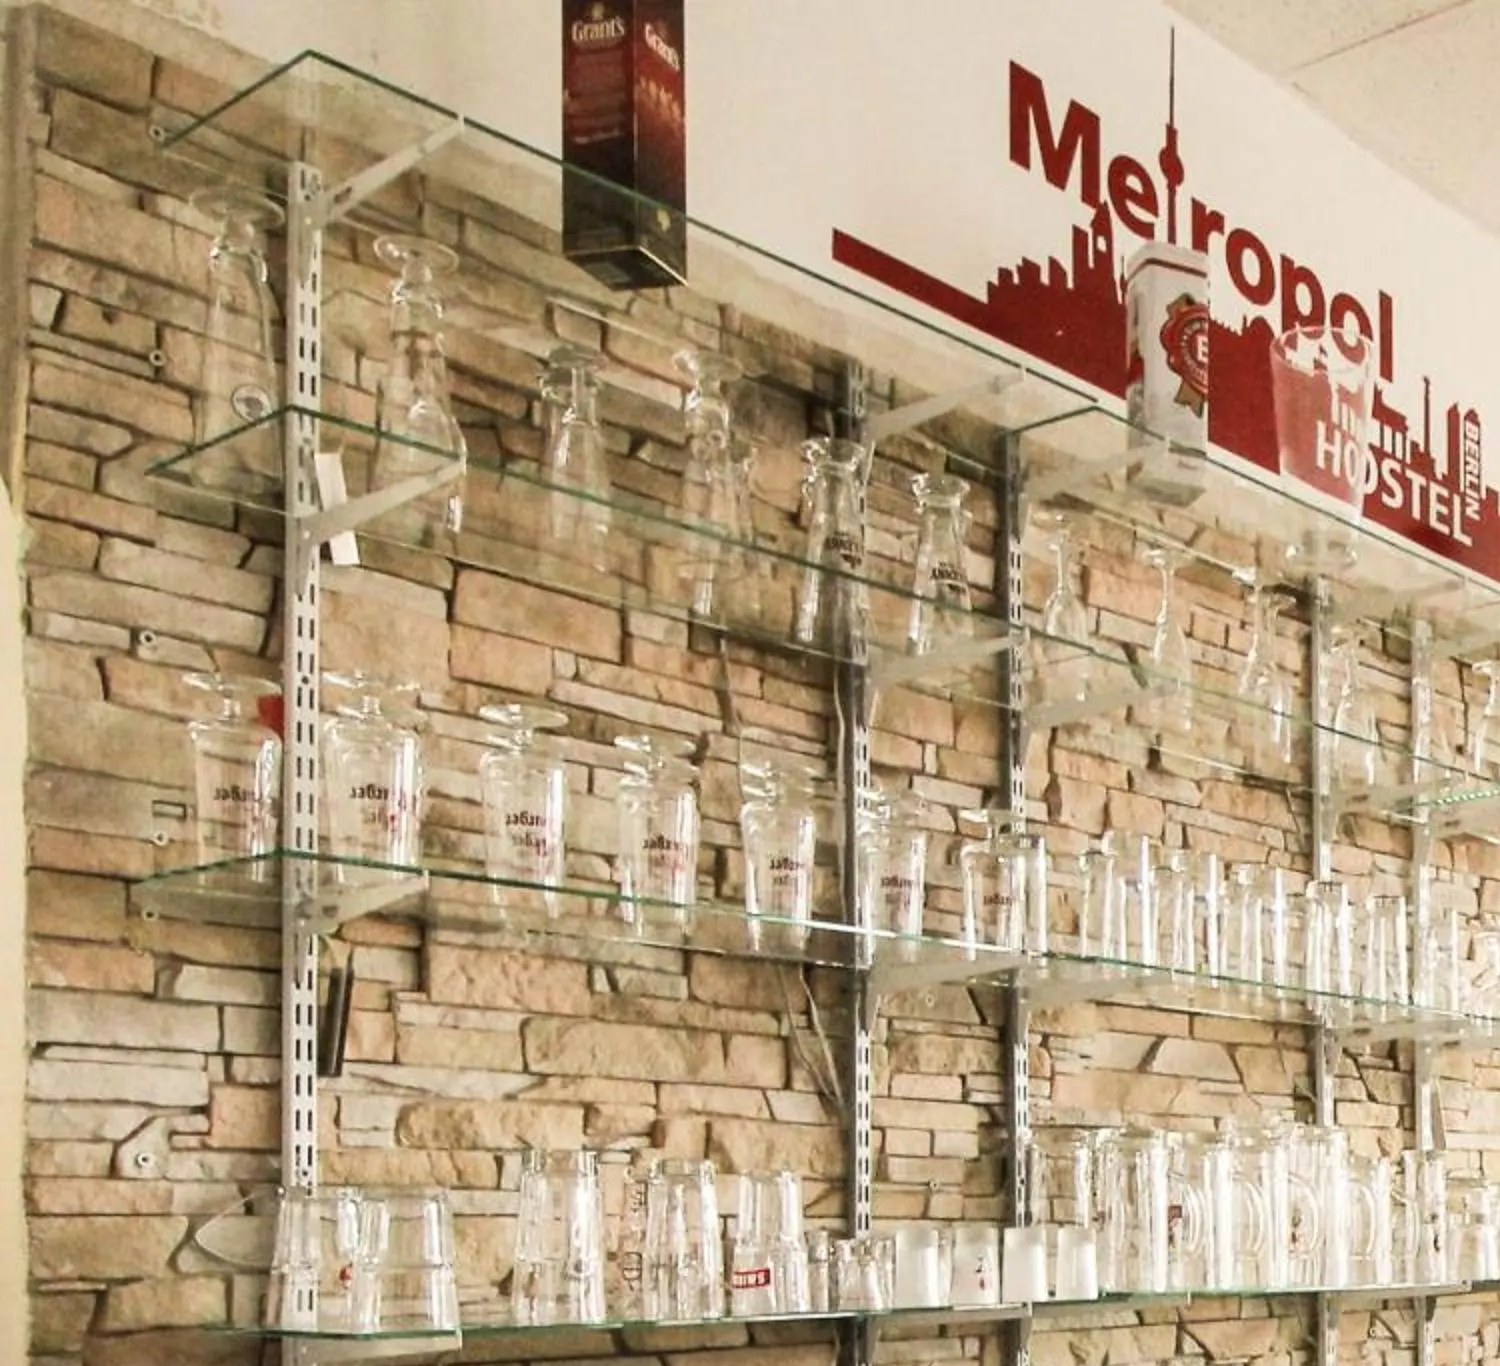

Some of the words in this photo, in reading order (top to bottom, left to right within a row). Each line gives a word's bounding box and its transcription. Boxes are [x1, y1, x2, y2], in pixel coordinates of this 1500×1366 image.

[1010, 60, 1393, 383] Metropol
[1316, 420, 1473, 547] HOSTEL
[1464, 421, 1481, 521] BERLIN
